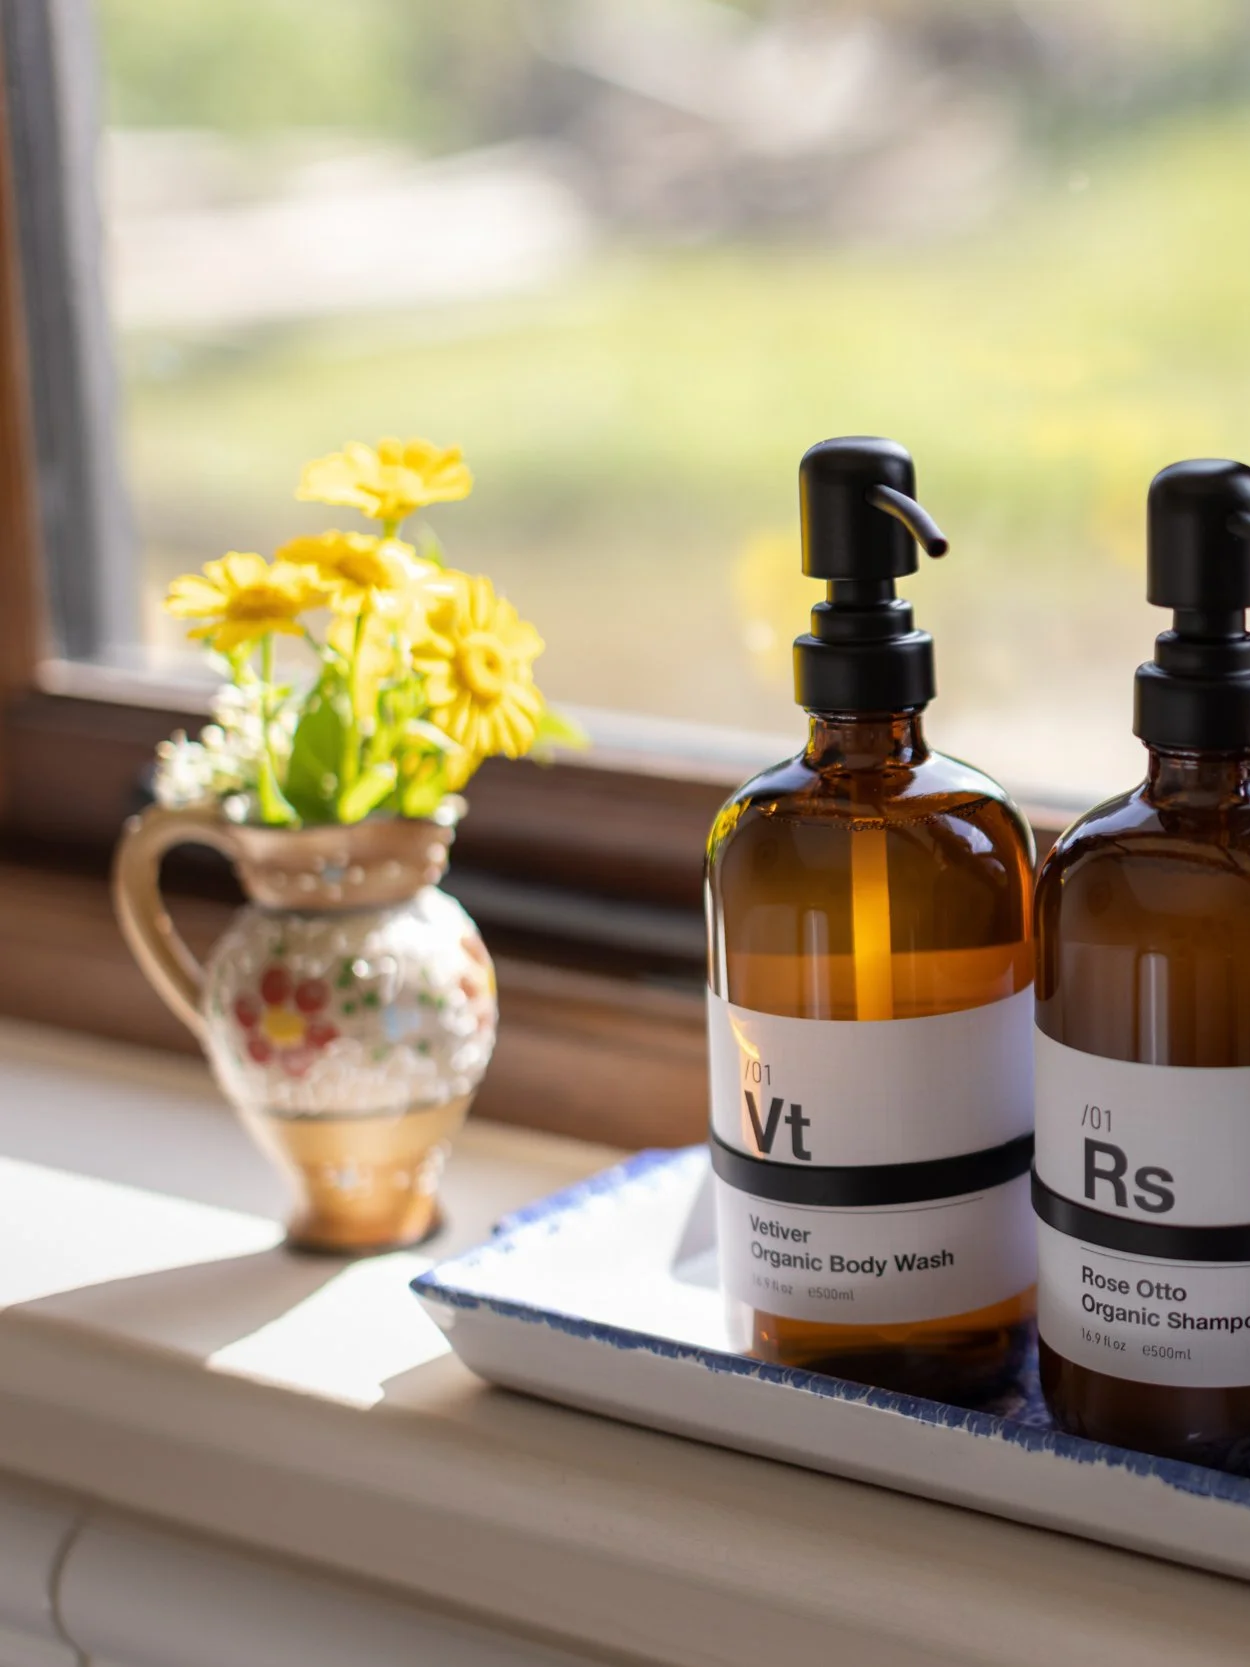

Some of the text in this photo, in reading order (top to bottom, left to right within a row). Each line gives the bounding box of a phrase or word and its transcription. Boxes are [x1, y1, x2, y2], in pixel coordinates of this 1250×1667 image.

[744, 1059, 771, 1086] /01
[744, 1090, 812, 1161] Vt
[1081, 1104, 1111, 1132] /01
[1084, 1136, 1175, 1213] Rs
[749, 1214, 811, 1243] Vetiver
[751, 1241, 954, 1277] Organic Body Wash
[1082, 1265, 1187, 1301] Rose Otto
[1081, 1293, 1160, 1327] Organic
[1081, 1327, 1101, 1345] 16.9
[1113, 1340, 1126, 1351] oz
